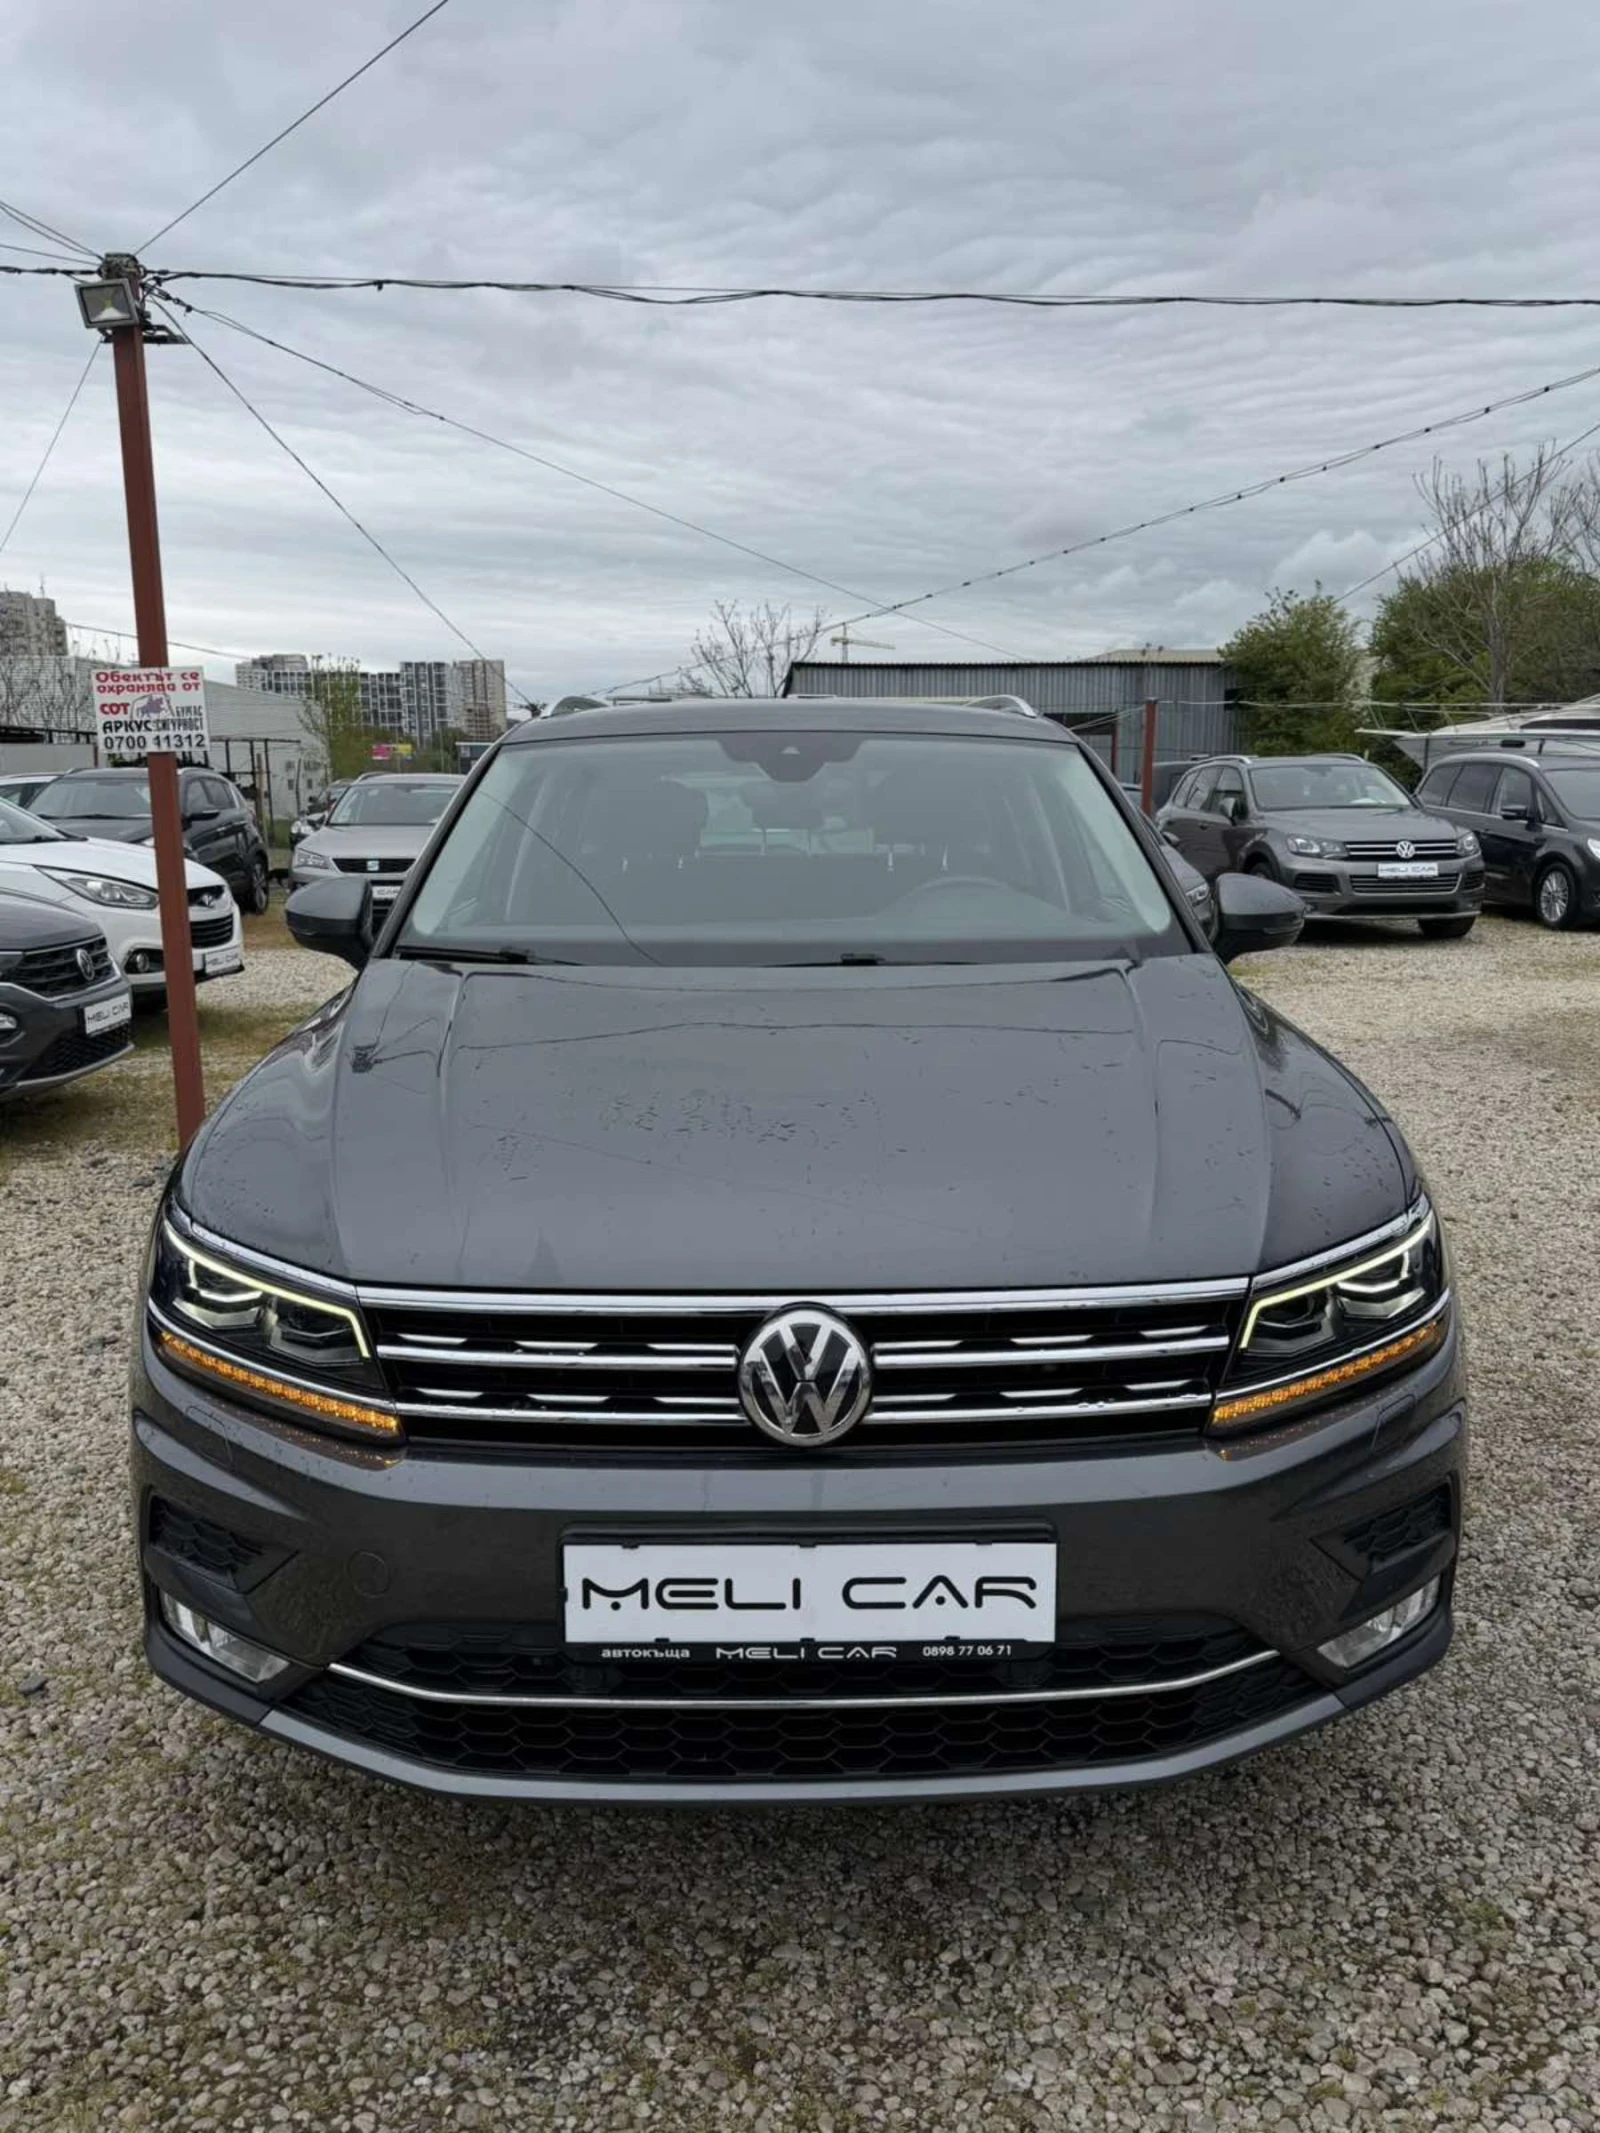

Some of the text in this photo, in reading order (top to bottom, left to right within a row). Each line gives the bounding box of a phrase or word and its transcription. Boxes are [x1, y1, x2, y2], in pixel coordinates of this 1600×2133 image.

[96, 671, 200, 683] Обектът се
[96, 682, 201, 695] охранява от
[99, 702, 130, 715] СОТ
[103, 719, 152, 734] АРКУС
[104, 734, 206, 750] 0700 11312
[582, 1575, 1037, 1610] MELI CAR
[600, 1647, 691, 1661] автокъща
[715, 1646, 898, 1660] MELI CAR
[922, 1644, 1012, 1657] 0898 77 06 71
